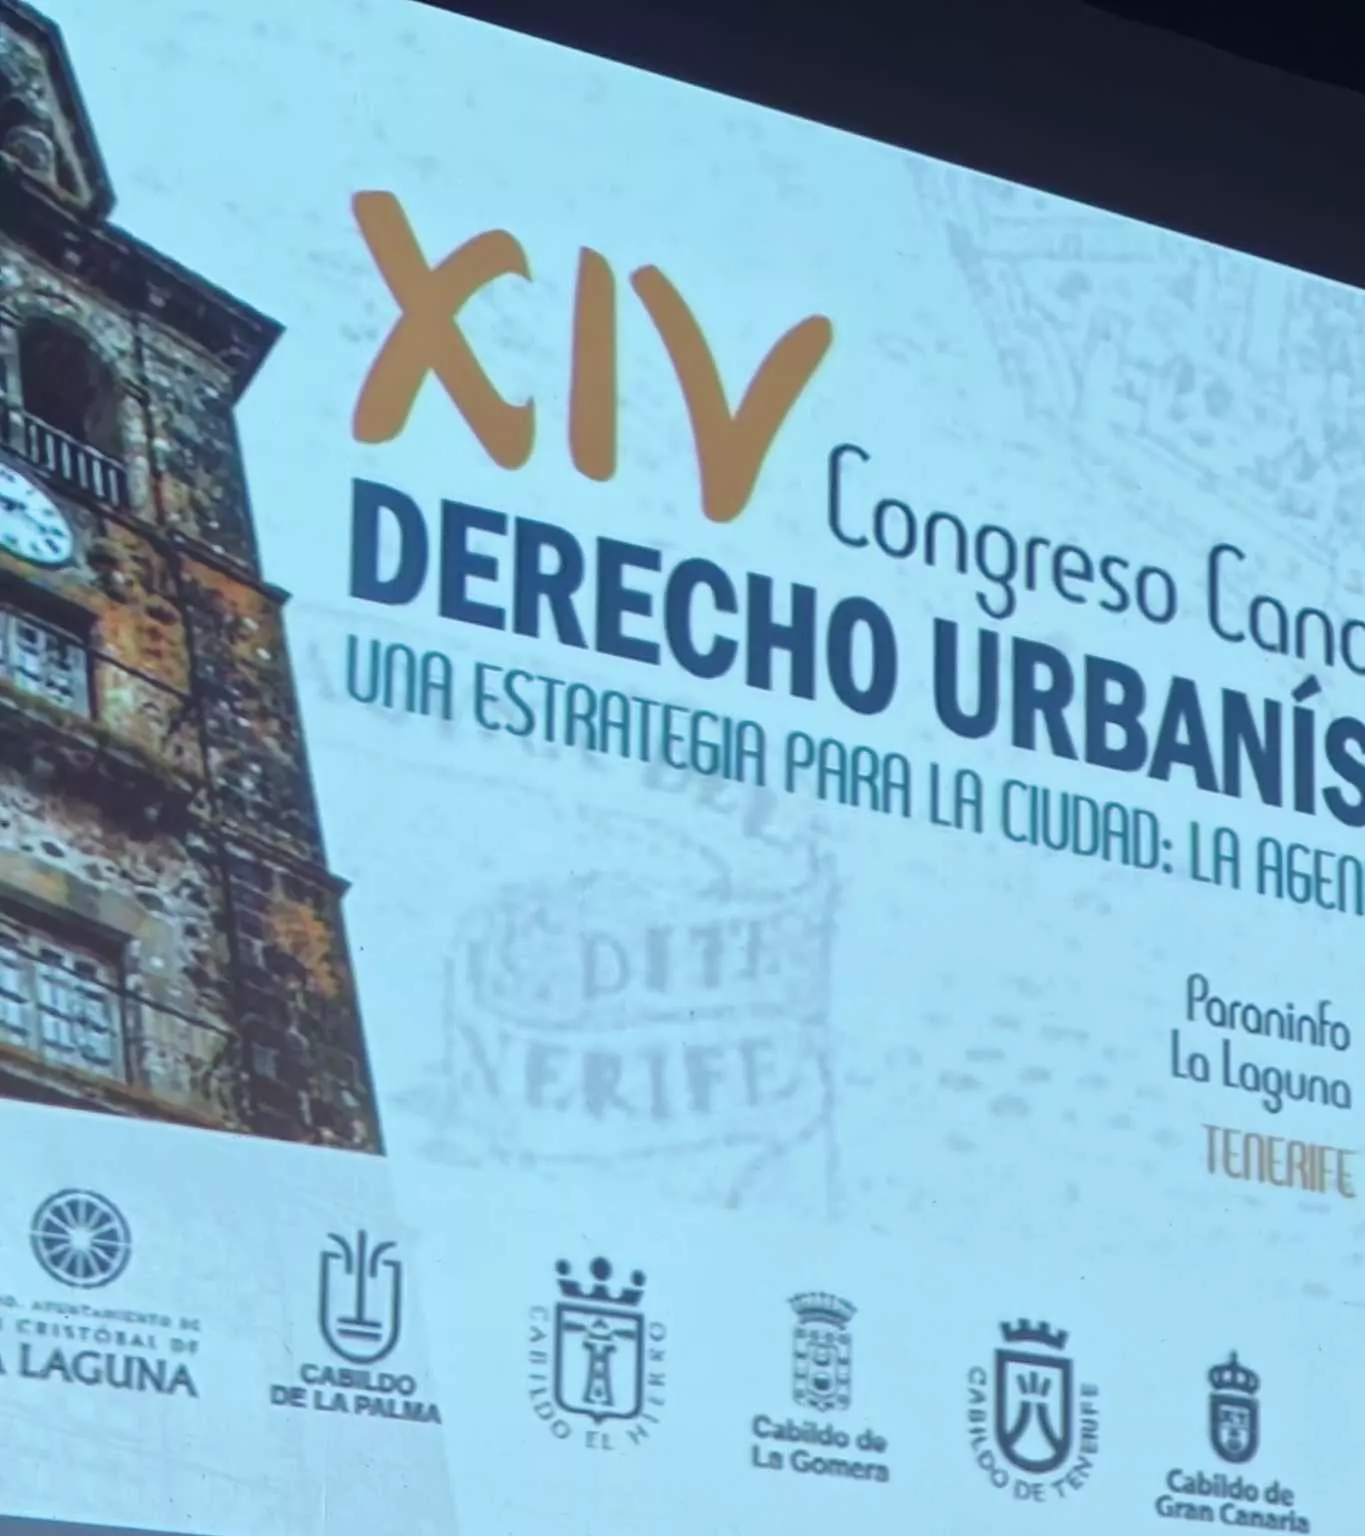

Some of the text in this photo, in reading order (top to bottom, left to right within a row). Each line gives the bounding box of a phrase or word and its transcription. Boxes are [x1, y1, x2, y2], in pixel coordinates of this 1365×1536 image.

[351, 190, 834, 524] XIV
[828, 443, 1178, 625] Congreso
[349, 477, 898, 716] DERECHO
[345, 635, 453, 722] UNA
[472, 663, 766, 789] ESTRATEGIA
[784, 731, 911, 819] PARA
[929, 762, 984, 835] LA
[1001, 779, 1175, 874] CIUDAD:
[1190, 821, 1241, 890] LA
[1186, 973, 1353, 1052] Paraninfo
[1171, 1028, 1353, 1115] La Laguna
[1202, 1123, 1357, 1200] TENERIFE
[19, 1342, 200, 1398] LAGUNA
[170, 1338, 200, 1355] DE
[301, 1362, 418, 1397] CABILDO
[528, 1305, 668, 1450] CABILDO EL HIERRO
[270, 1385, 442, 1426] DE LA PALMA
[751, 1414, 888, 1454] Cabildo de
[967, 1366, 1100, 1502] CABILDO DE TENERIFE
[751, 1445, 890, 1484] La Gomera
[1165, 1468, 1296, 1508] Cabildo de
[1154, 1494, 1311, 1535] Gran Canaria
